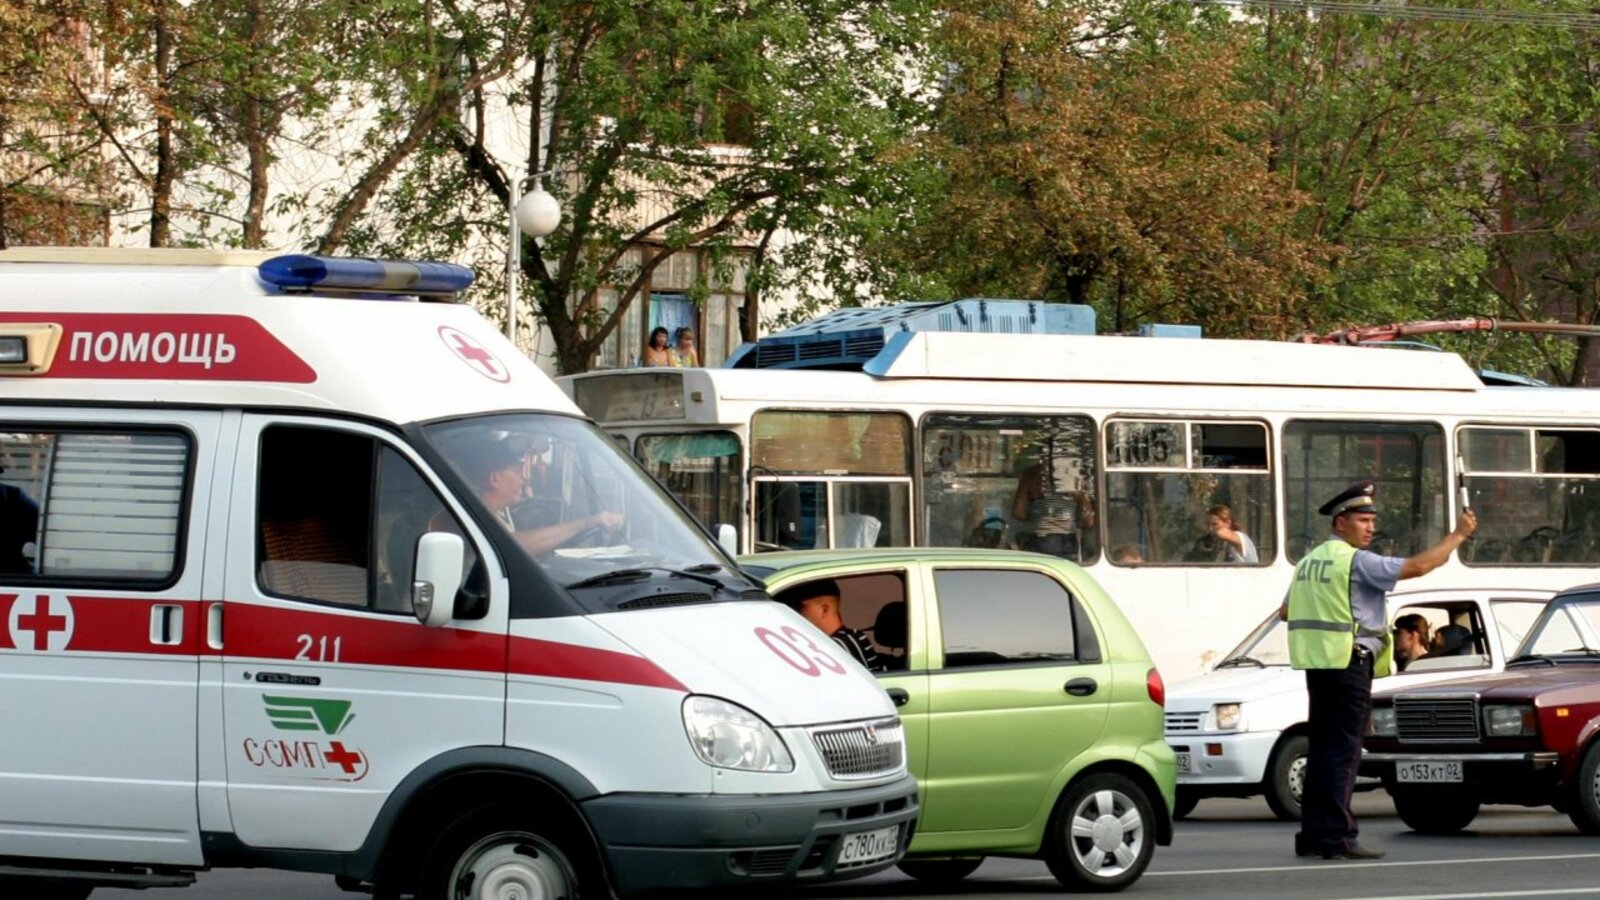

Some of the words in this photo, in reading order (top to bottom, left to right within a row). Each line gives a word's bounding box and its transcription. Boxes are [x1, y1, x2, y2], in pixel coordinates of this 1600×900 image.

[69, 331, 237, 370] ПОМОЩЬ
[1296, 559, 1334, 584] ДПС
[295, 633, 341, 662] 211
[753, 625, 847, 677] 03
[243, 737, 326, 769] ССМП
